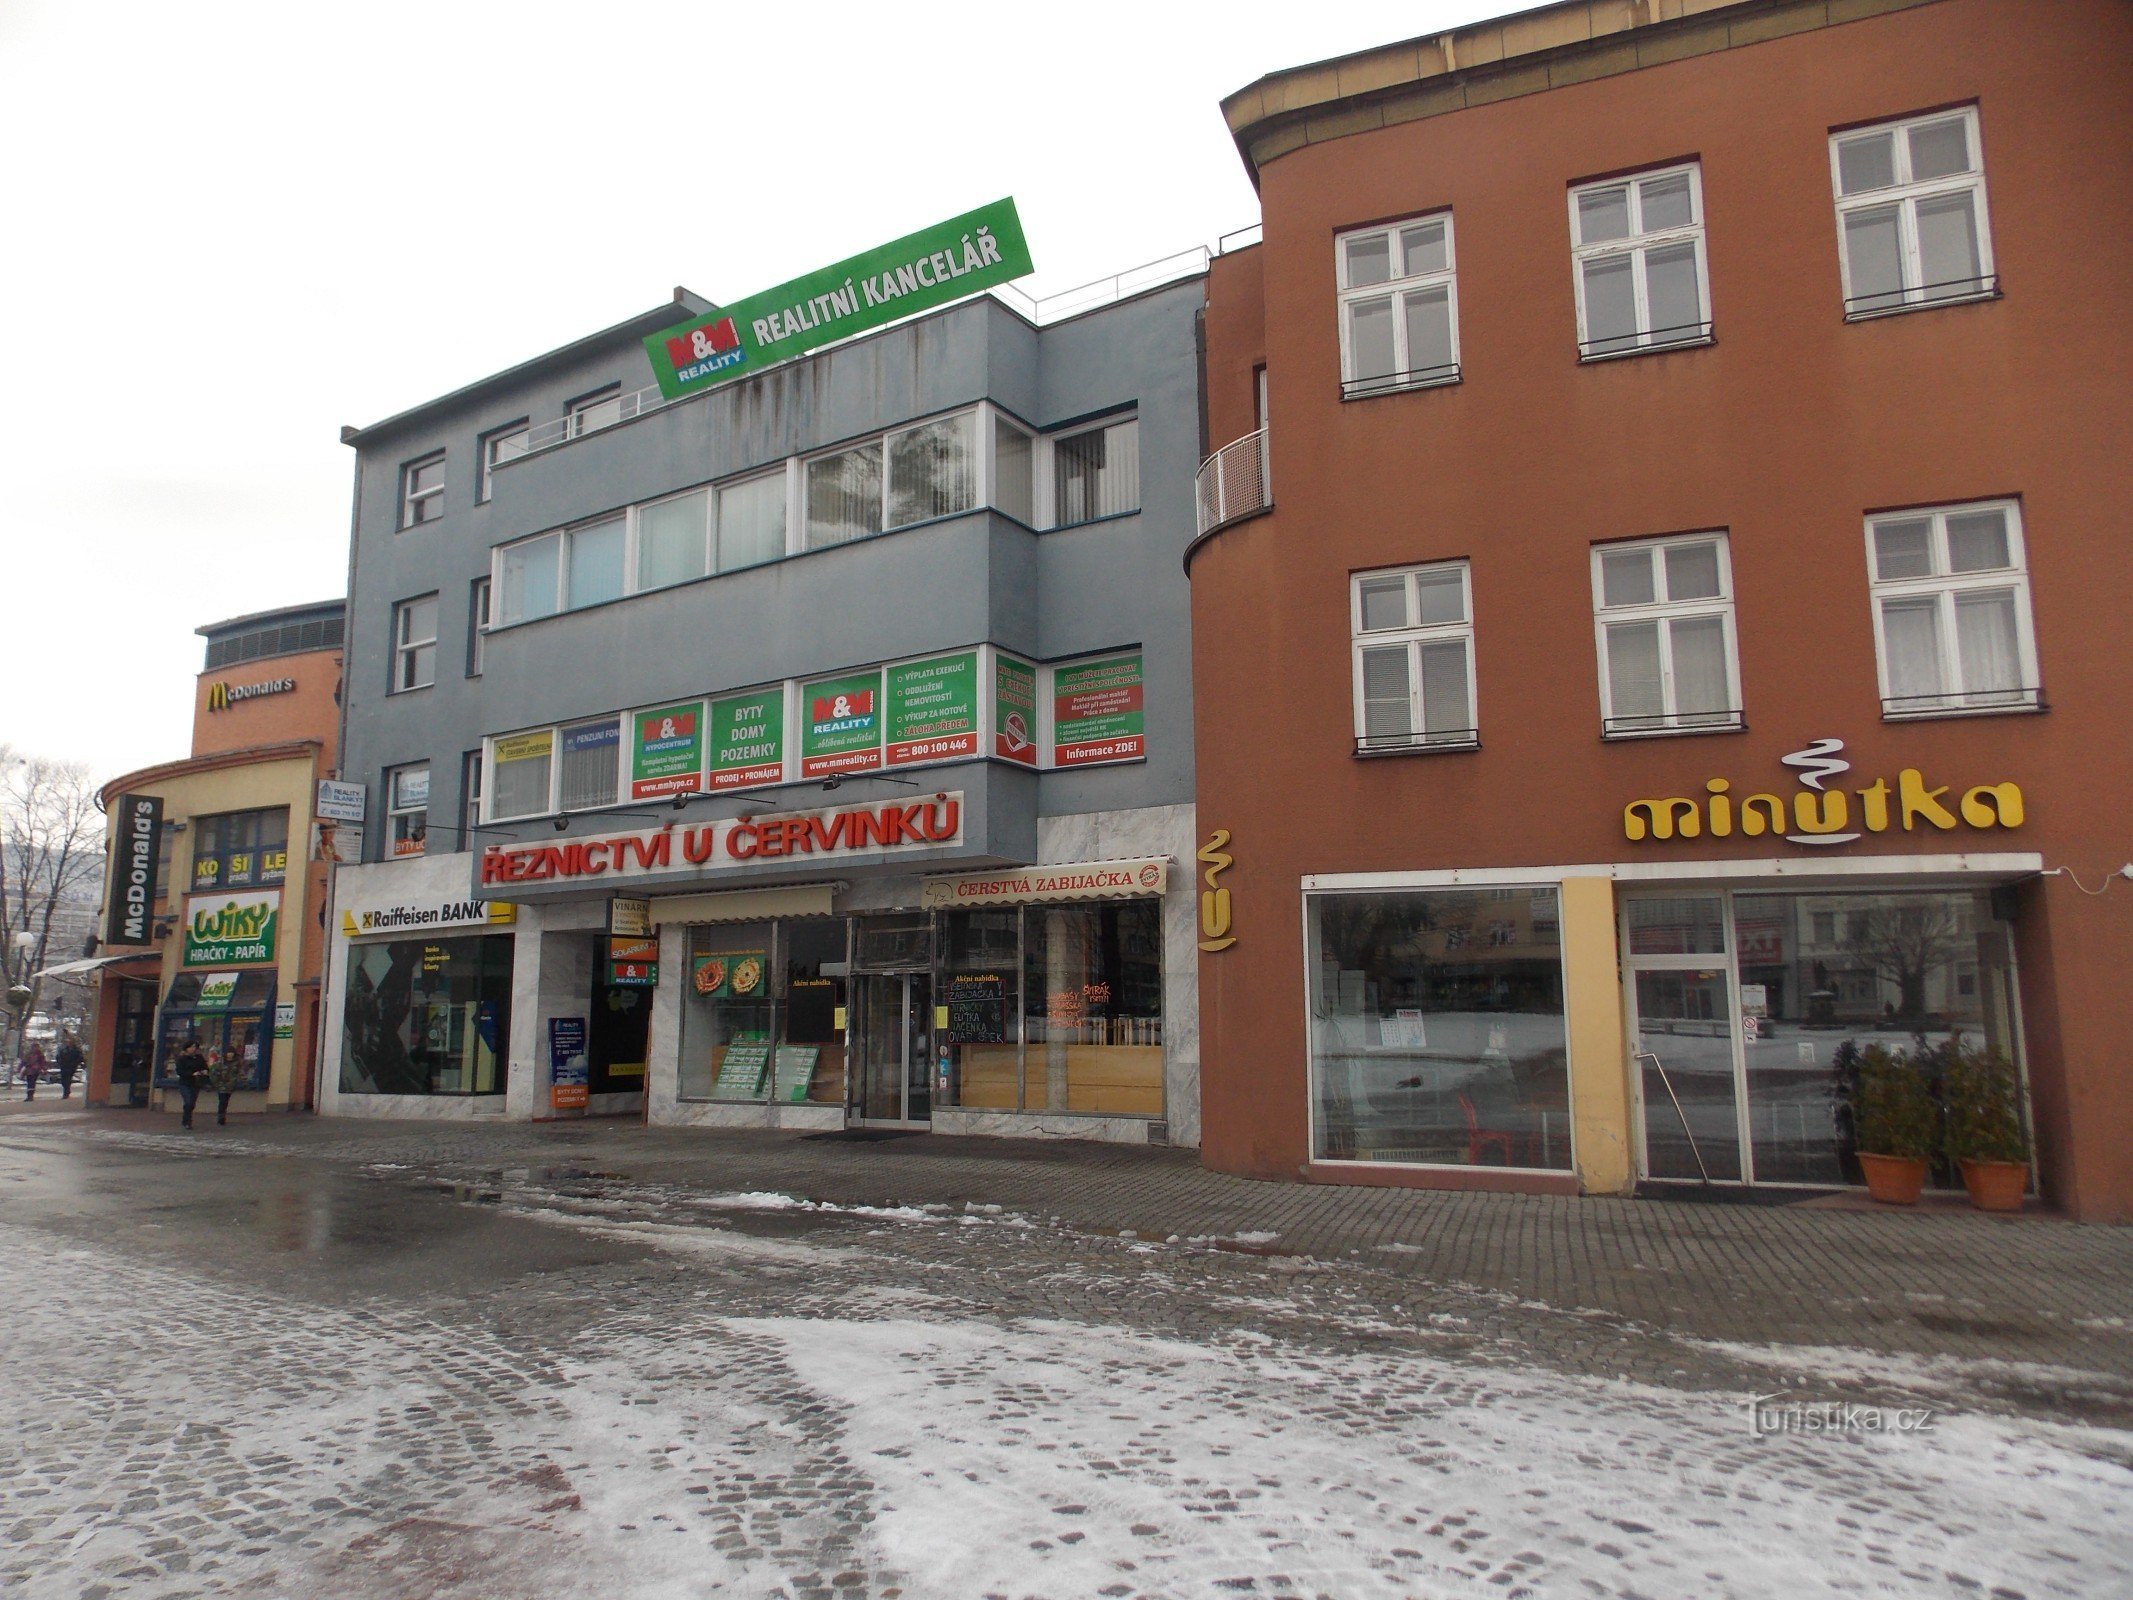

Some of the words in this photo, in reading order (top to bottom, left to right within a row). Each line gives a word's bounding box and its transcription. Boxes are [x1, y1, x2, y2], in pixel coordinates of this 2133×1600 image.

[752, 277, 859, 347] REALITNÍ
[862, 225, 1003, 309] KANCELÁŘ
[665, 316, 738, 369] M&M
[678, 350, 741, 382] REALITY
[905, 668, 935, 681] VÝPLATA
[936, 662, 966, 675] EXEKUCÍ
[905, 681, 943, 695] ODDLUŽENÍ
[813, 690, 870, 722] M&M
[905, 691, 952, 707] NEMOVITOSTÍ
[735, 705, 764, 722] BYTY
[905, 711, 928, 721] VÝKUP
[929, 709, 938, 718] ZA
[940, 703, 968, 714] HOTOVÉ
[731, 724, 766, 741] DOMY
[813, 717, 871, 733] REALITY
[904, 723, 935, 736] ZÁLOHA
[936, 718, 968, 732] PŘEDEM
[720, 742, 776, 762] POZEMKY
[911, 745, 929, 756] 800
[931, 742, 948, 753] 100
[949, 739, 968, 750] 446
[1066, 745, 1113, 759] Informace
[1115, 741, 1137, 753] ZDE!
[809, 754, 878, 770] www.mmreality.cz
[715, 774, 739, 784] PRODEJ
[744, 768, 780, 781] PRONÁJEM
[640, 779, 694, 793] www.mmhypo.cz
[1624, 767, 2025, 841] minutka
[481, 822, 672, 884] ŘEZNICTVÍ
[683, 828, 713, 864] U
[726, 793, 959, 859] ČERVINKŮ
[124, 801, 153, 939] McDonald's
[197, 859, 218, 876] KO
[264, 852, 286, 869] LE
[957, 876, 1031, 896] ČERSTVÁ
[1036, 870, 1133, 891] ZABIJAČKA
[373, 905, 438, 928] Raiffeisen
[441, 900, 485, 921] BANK
[615, 902, 648, 913] VINÁRN
[190, 946, 229, 962] HRAČKY
[235, 943, 266, 959] PAPÍR
[974, 974, 999, 982] nabídka
